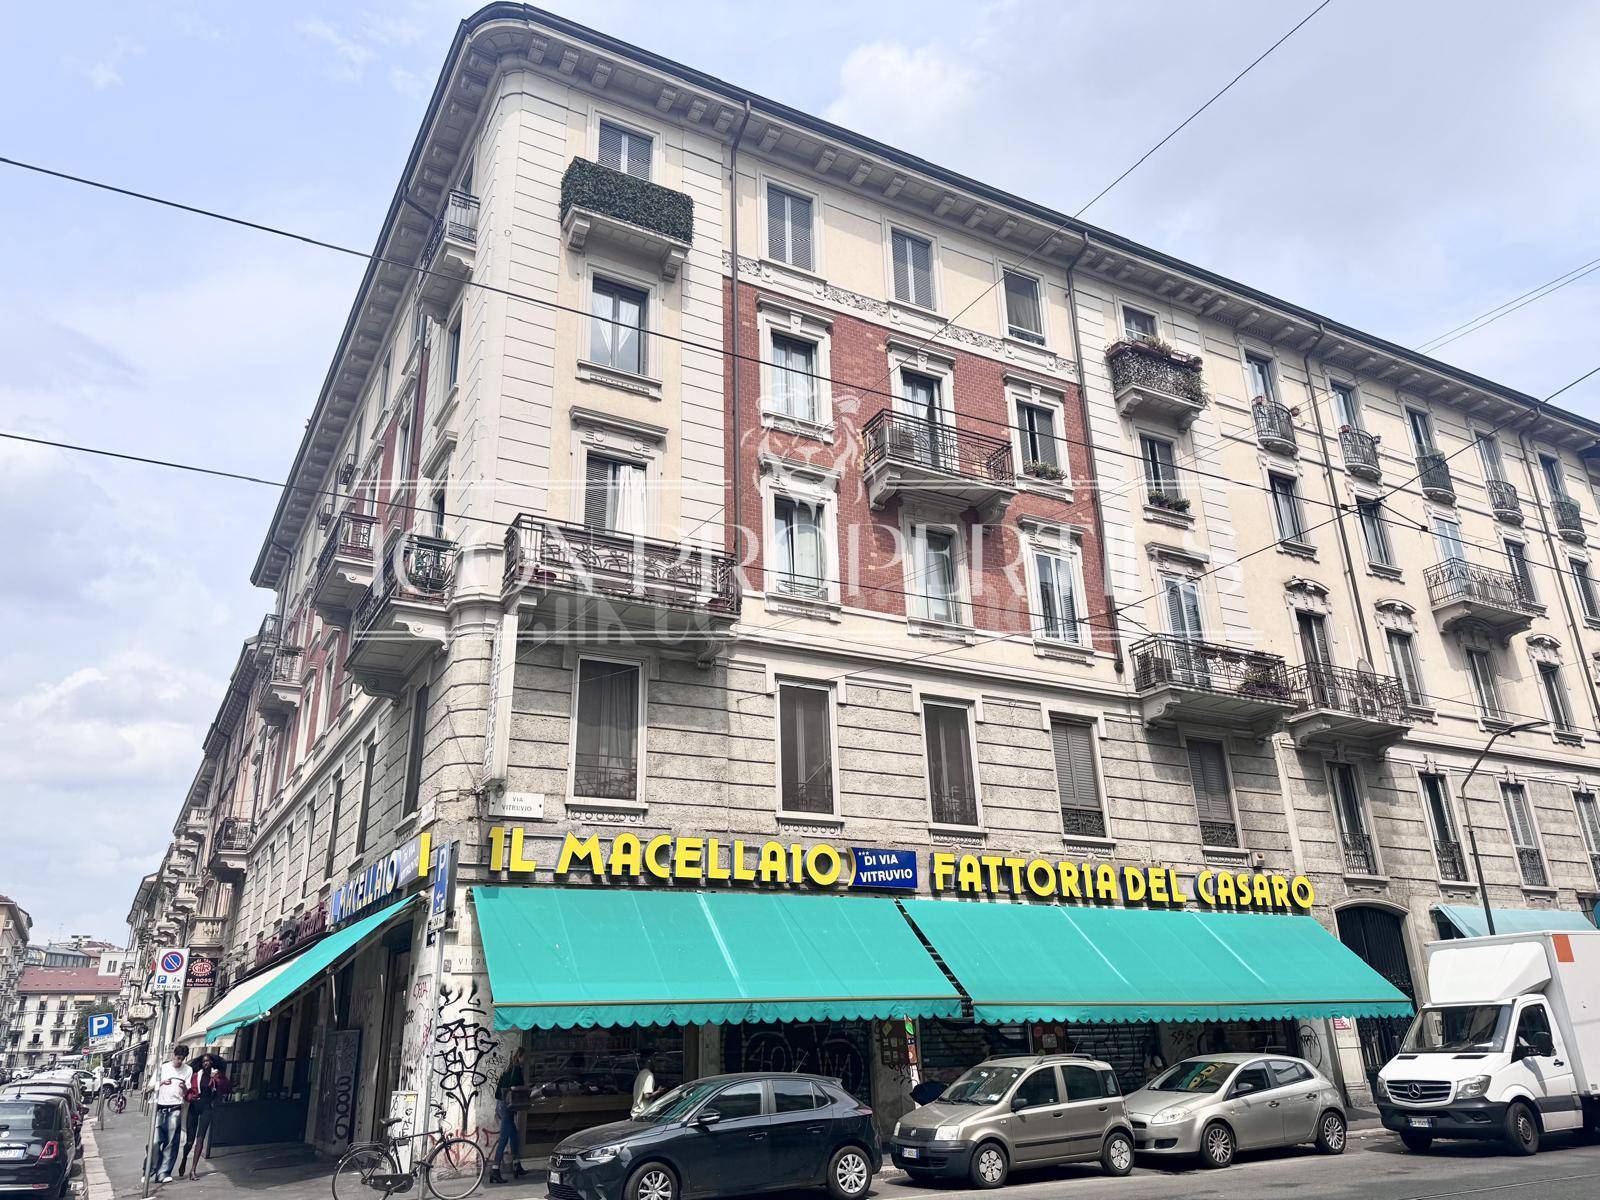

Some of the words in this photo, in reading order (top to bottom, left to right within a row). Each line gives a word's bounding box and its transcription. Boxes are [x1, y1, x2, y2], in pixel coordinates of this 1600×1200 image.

[501, 804, 532, 812] VITRUVIO
[437, 847, 446, 882] P
[489, 826, 537, 873] IL
[556, 831, 842, 886] MACELLAIO
[863, 854, 877, 867] DI
[879, 854, 899, 866] VIA
[858, 868, 914, 883] VITRUVIO
[931, 852, 1118, 900] FATTORIA
[1124, 866, 1187, 904] DEL
[1197, 870, 1316, 909] CASARO
[92, 1016, 109, 1036] P
